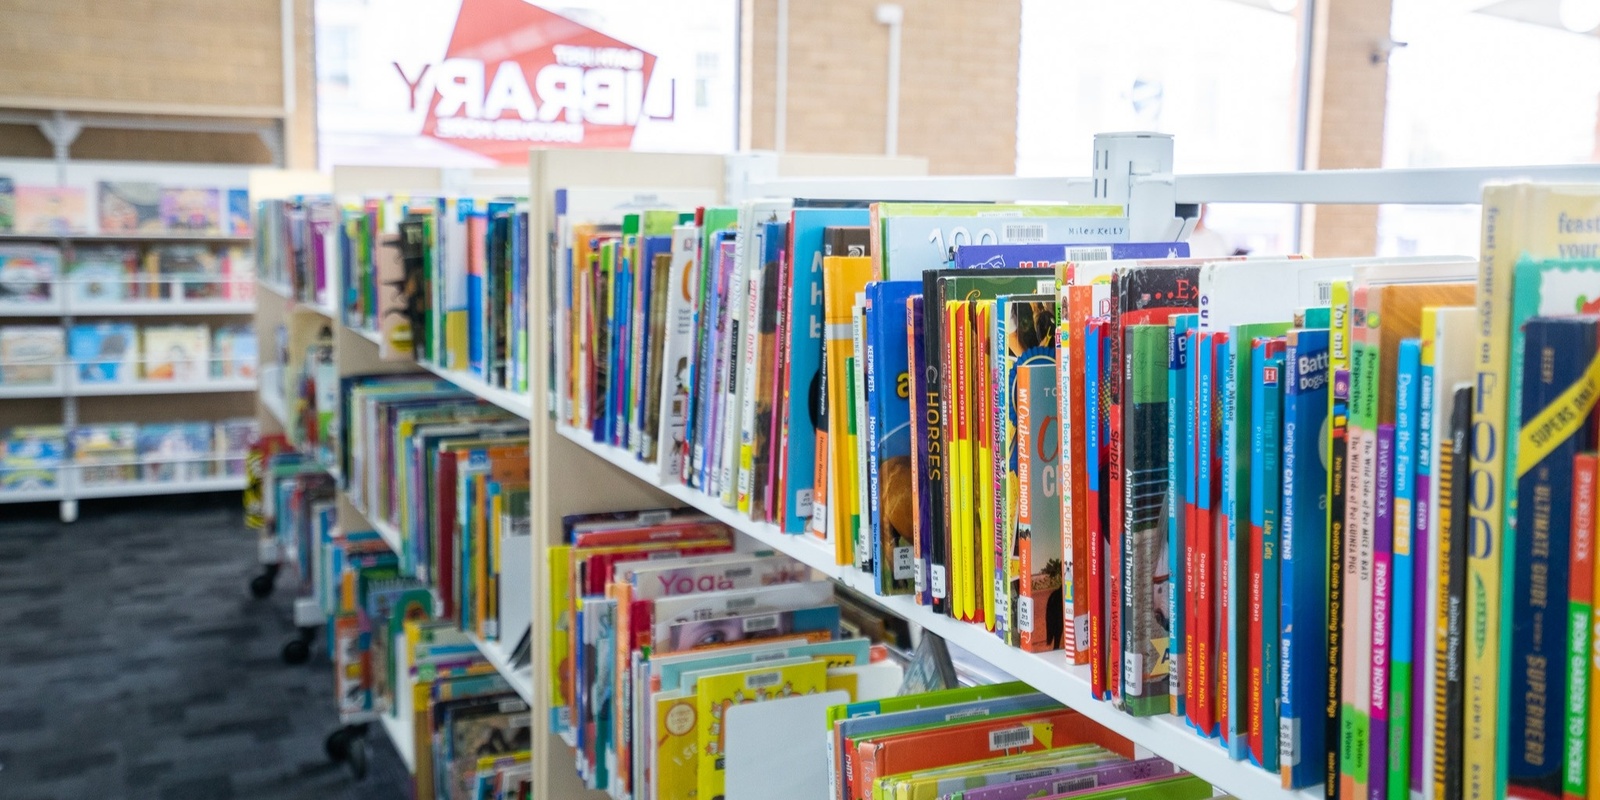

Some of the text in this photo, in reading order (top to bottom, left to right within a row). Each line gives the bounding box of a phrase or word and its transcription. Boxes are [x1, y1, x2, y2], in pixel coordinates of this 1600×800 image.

[1483, 256, 1496, 294] your
[1111, 296, 1119, 358] EXTREME
[1333, 303, 1347, 359] You and
[1300, 376, 1323, 390] Dogs
[1352, 349, 1363, 414] Perspectives
[1365, 353, 1376, 418] Perspectives
[1168, 398, 1176, 423] Caring
[1397, 373, 1412, 491] Down on the Farm
[1419, 375, 1432, 466] CARING FOR MY PET
[869, 417, 877, 452] Horses
[926, 392, 941, 480] HORSES
[1018, 389, 1029, 518] MY Outback CHILDHOOD
[1063, 448, 1070, 459] of
[1110, 430, 1119, 480] SPIDER
[1351, 436, 1359, 450] The
[1364, 440, 1372, 454] The
[1350, 455, 1359, 474] Wild
[1350, 475, 1359, 491] Side
[1363, 456, 1372, 477] Wild
[1377, 446, 1388, 519] WORLD BOOK
[1469, 372, 1497, 559] FOOD
[1283, 423, 1296, 560] Caring for CATS and KITTENS
[1350, 495, 1358, 504] of
[1362, 500, 1371, 510] of
[1363, 480, 1371, 497] Side
[1064, 505, 1072, 549] PUPPIES
[1124, 510, 1133, 555] Physical
[1349, 523, 1357, 553] GUINEA
[1361, 528, 1370, 547] MICE
[1395, 504, 1409, 547] BEES
[1531, 485, 1551, 558] ULTIMATE
[1124, 556, 1133, 607] Therapist
[1348, 555, 1356, 574] PIGS
[1361, 560, 1369, 580] RATS
[1529, 563, 1548, 608] GUIDE
[1327, 522, 1341, 718] Gordon's Guide to Caring for Your Guinea Pigs
[1372, 562, 1386, 709] FROM FLOWER TO HONEY
[1448, 596, 1459, 635] Animal
[1281, 639, 1290, 703] Ben Hubbard
[1252, 667, 1260, 736] ELIZABETH NOLL
[1523, 655, 1548, 766] SUPERHERO
[1568, 612, 1589, 787] FROM GARDEN TO PICKLE
